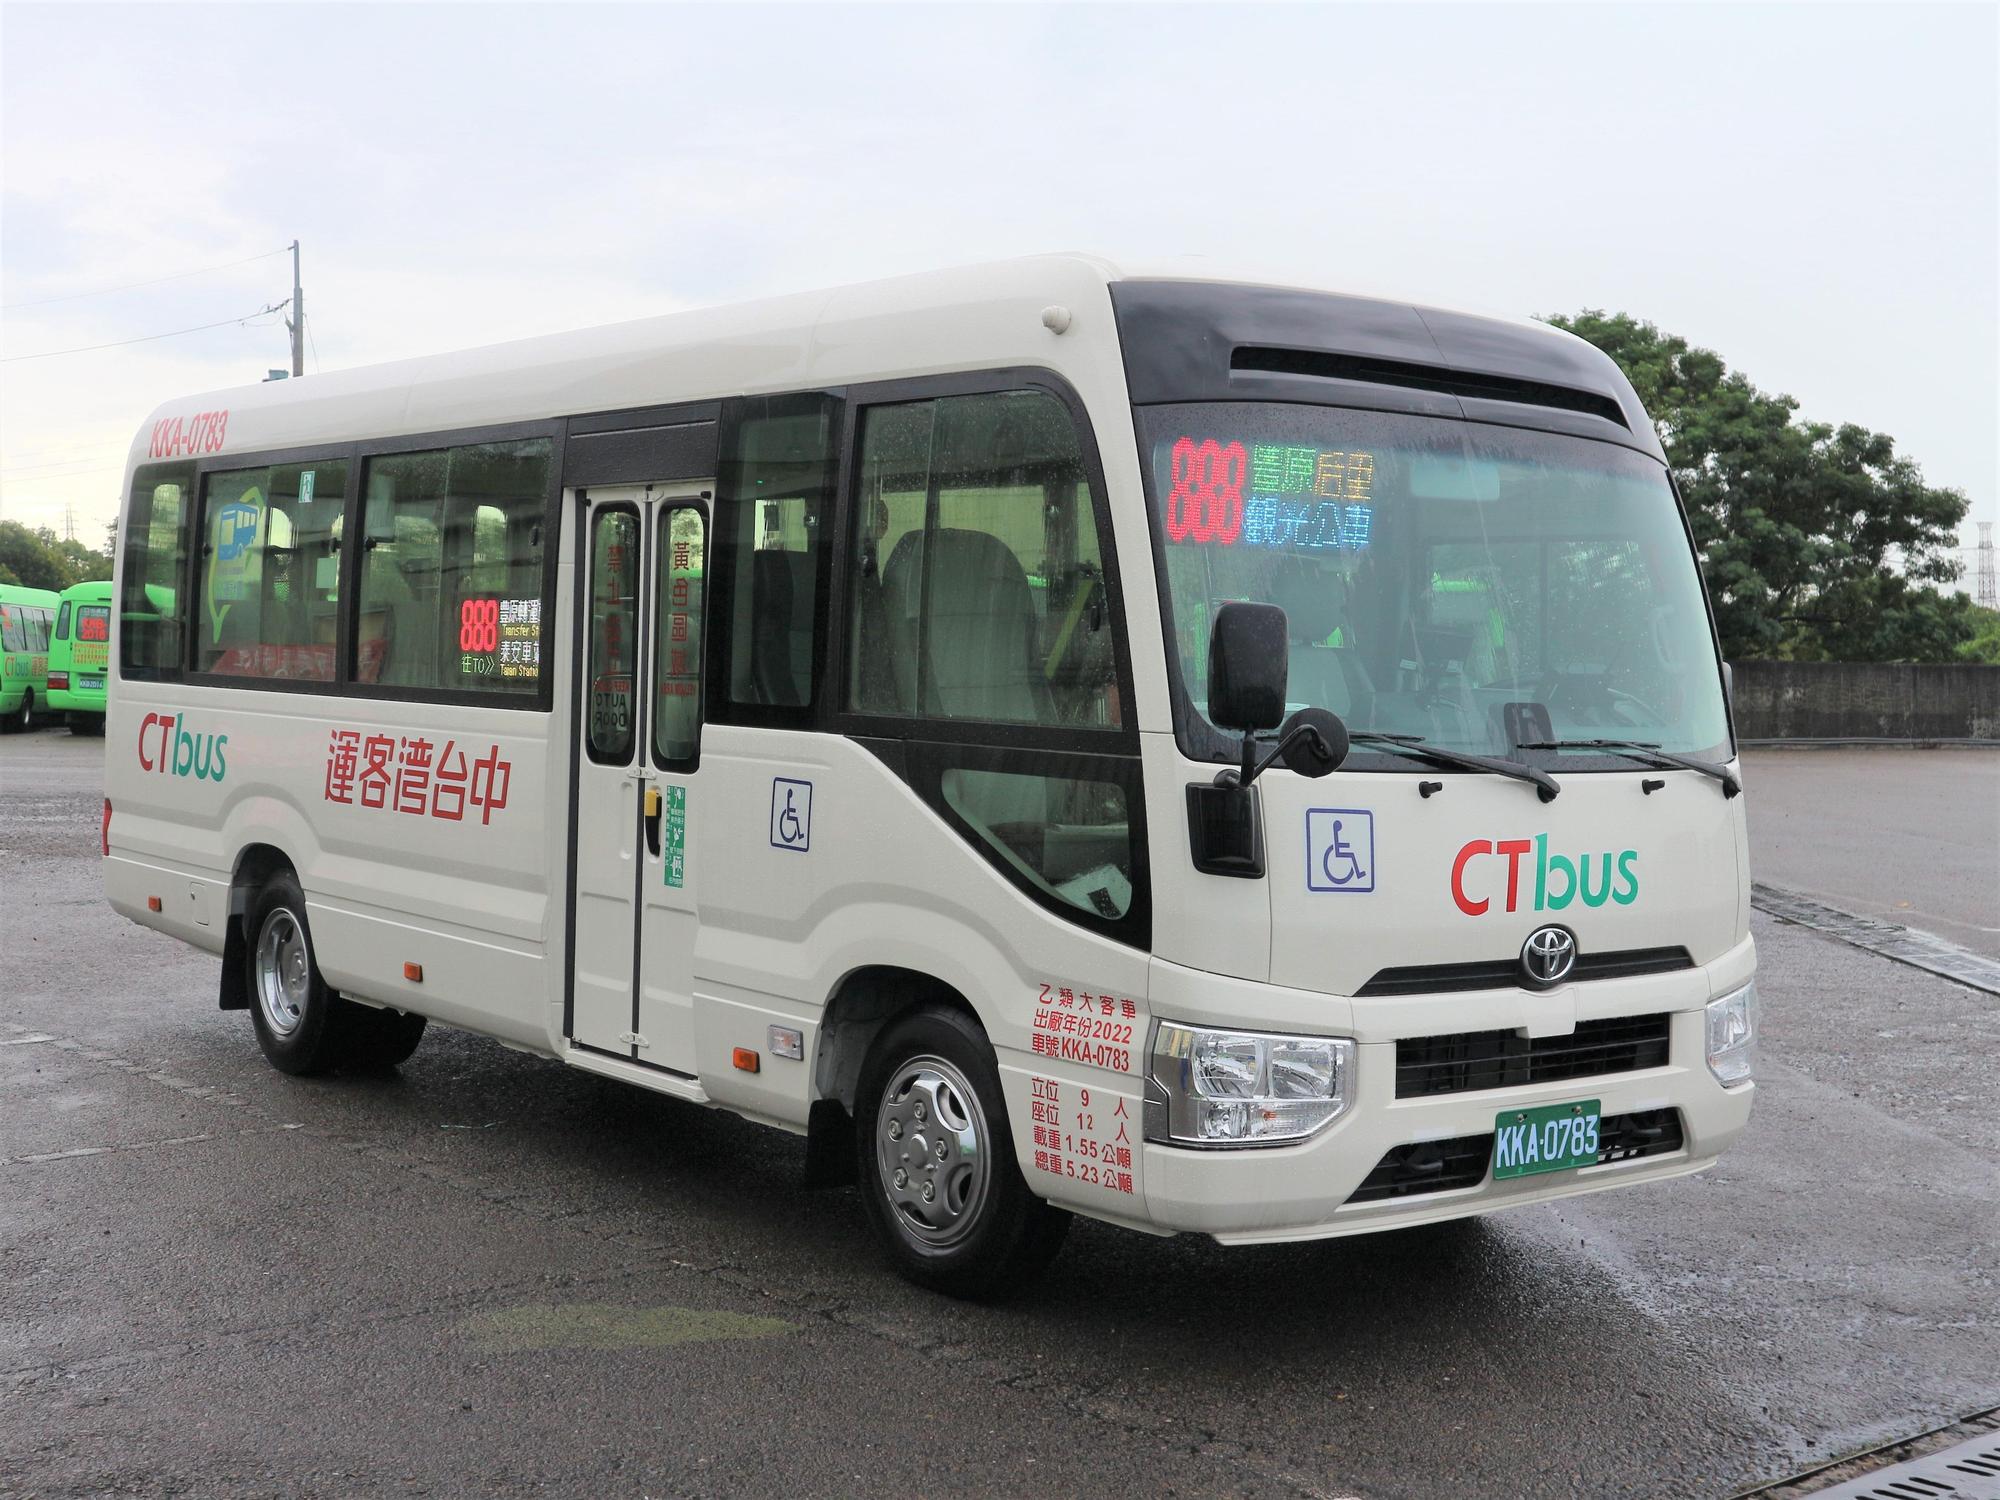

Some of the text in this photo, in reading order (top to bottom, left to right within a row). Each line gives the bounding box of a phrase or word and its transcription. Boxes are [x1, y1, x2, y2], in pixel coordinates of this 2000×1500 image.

[149, 409, 228, 458] KKA-0783
[1166, 437, 1247, 545] 888
[461, 599, 498, 652] 888
[499, 599, 541, 624] 豐原轉運
[502, 624, 529, 637] Transfer
[139, 712, 228, 782] CTbus
[1451, 832, 1639, 917] CTbus
[1077, 1113, 1093, 1130] 12
[1115, 1122, 1130, 1145] 人
[1081, 1089, 1089, 1107] 9
[1114, 1097, 1129, 1120] 人
[1496, 1114, 1598, 1169] KKA-0783
